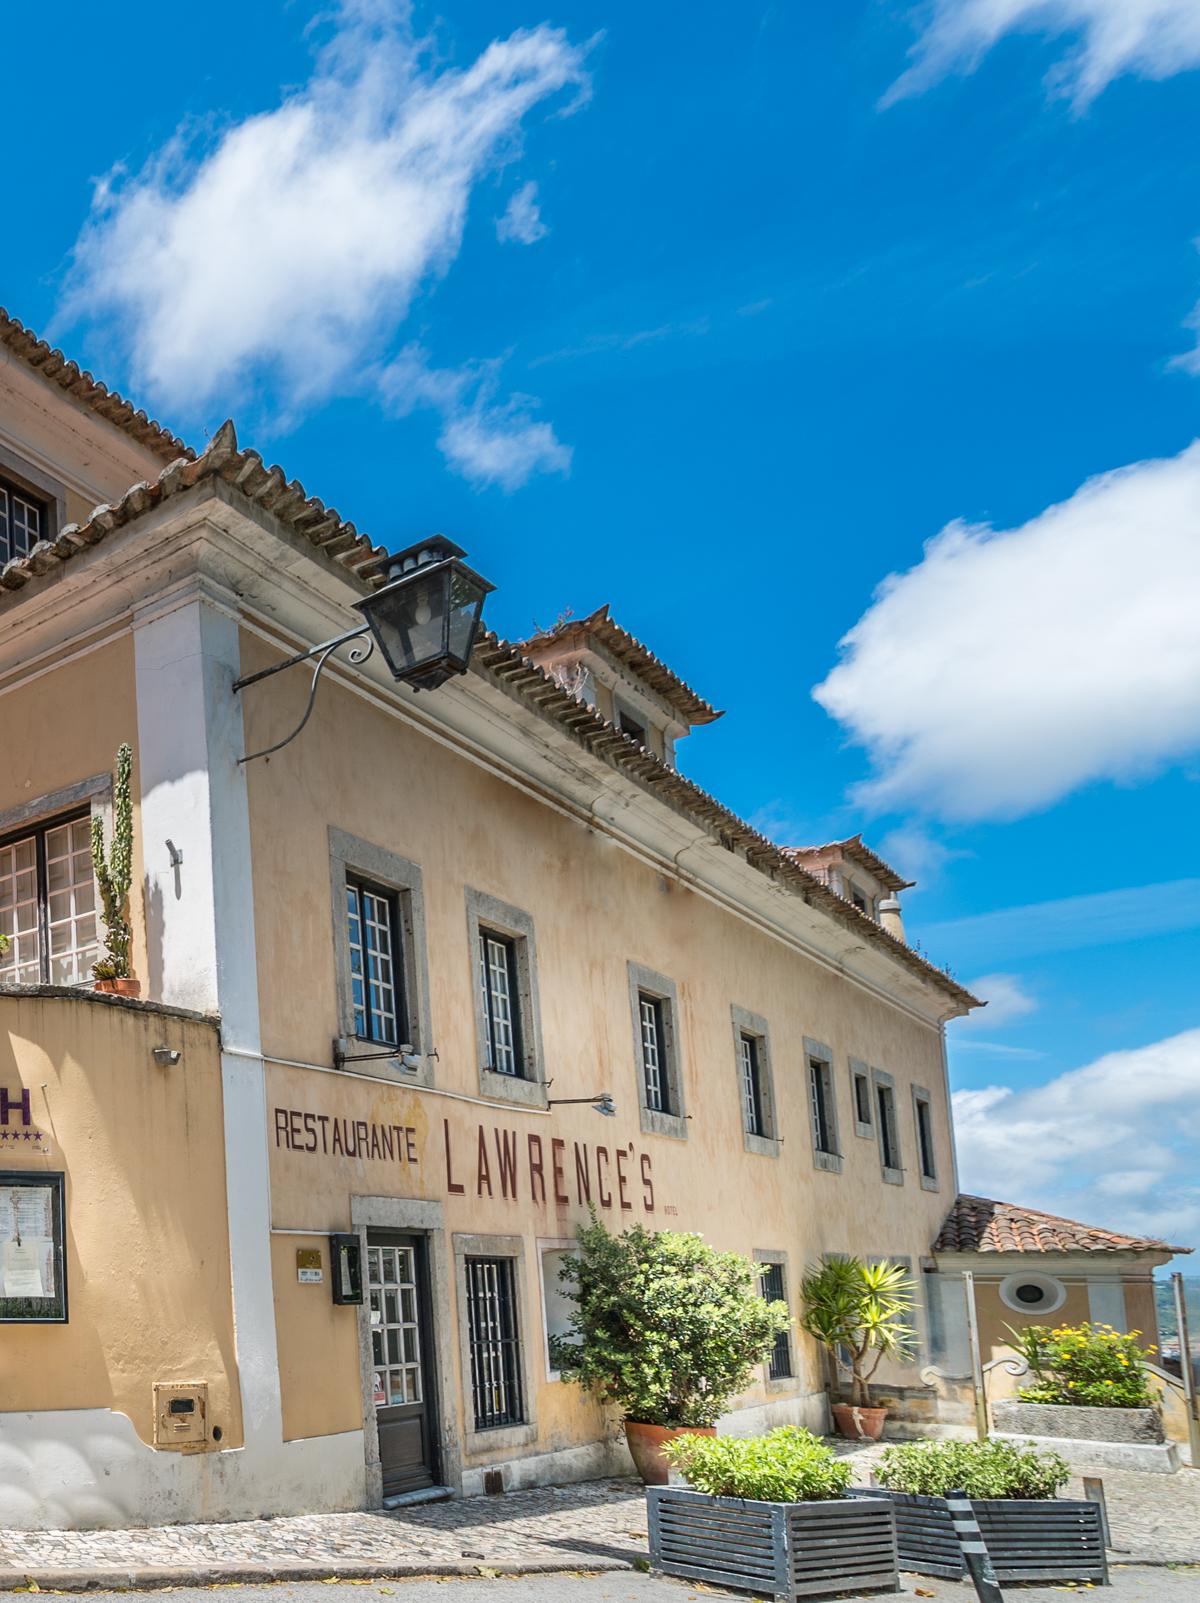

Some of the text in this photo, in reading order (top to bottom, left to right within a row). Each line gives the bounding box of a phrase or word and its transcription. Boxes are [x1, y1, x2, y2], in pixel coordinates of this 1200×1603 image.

[0, 1088, 31, 1126] H
[274, 1107, 418, 1163] RESTAURANTE
[443, 1118, 655, 1212] LAWRENCE'S
